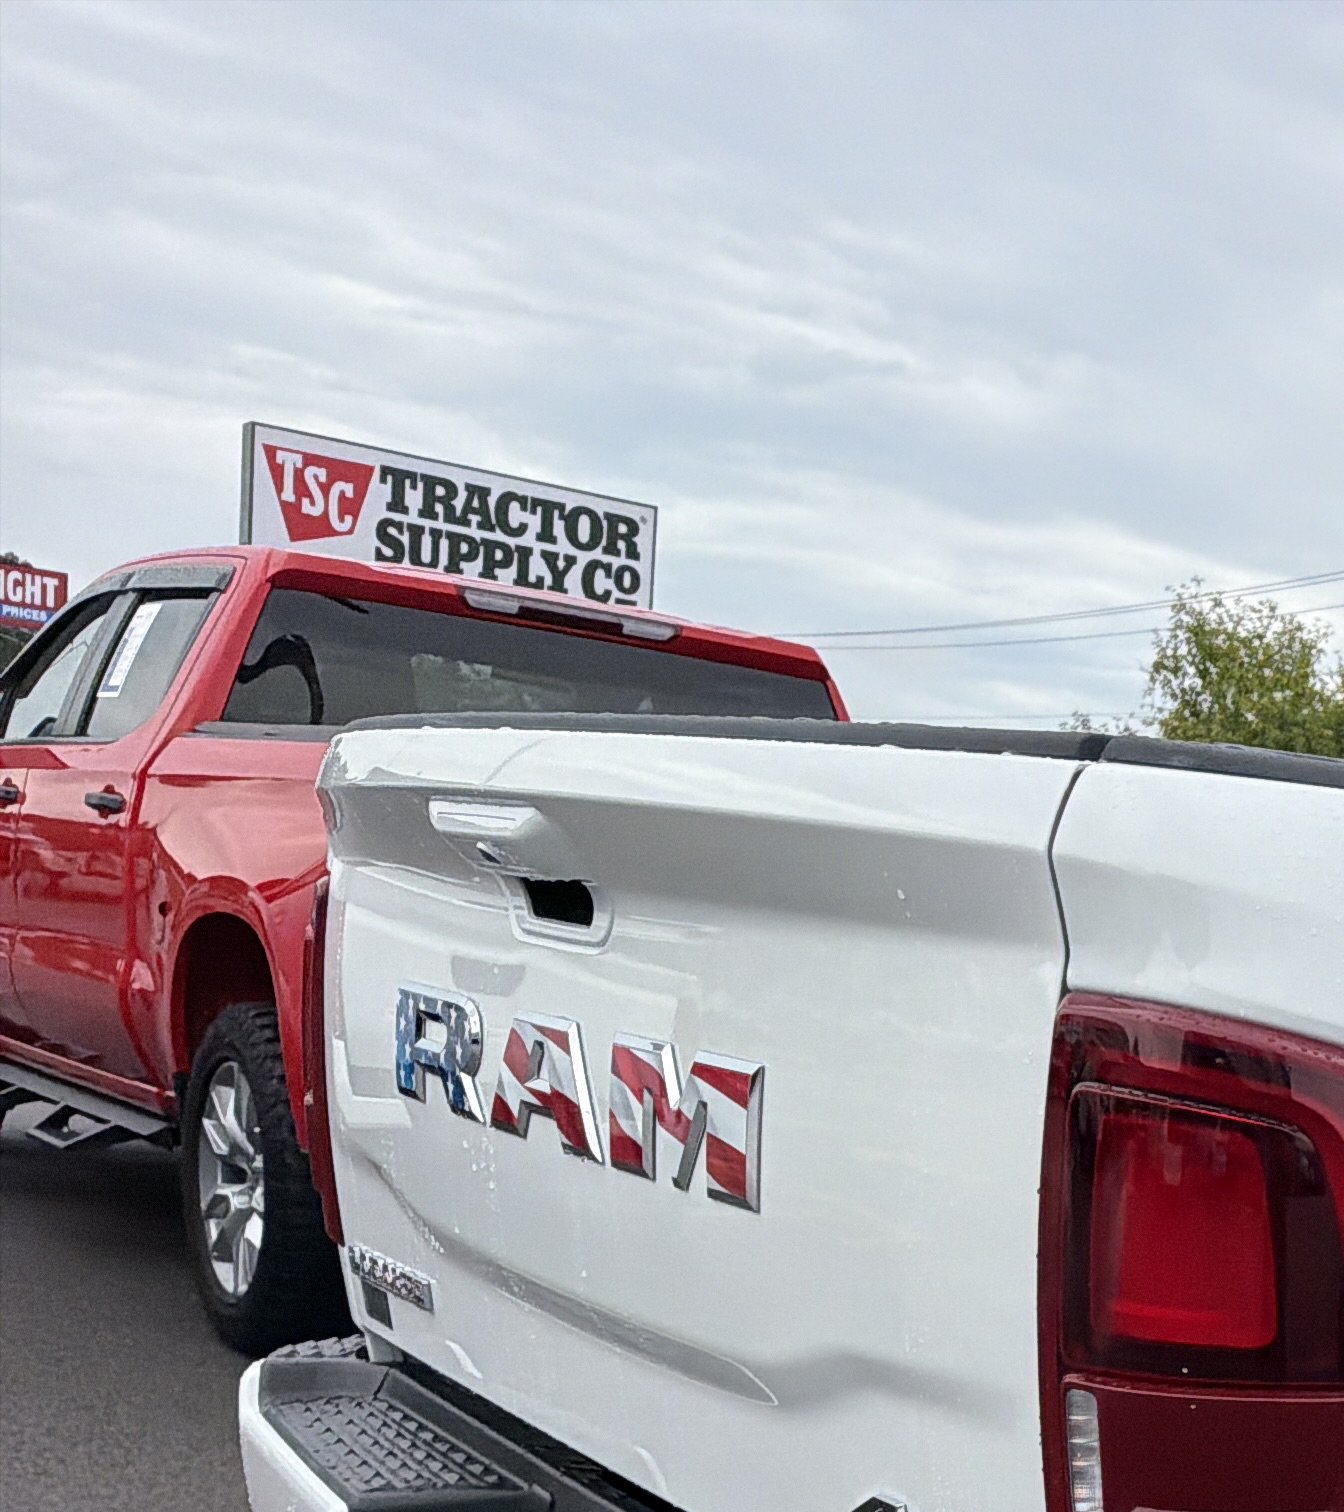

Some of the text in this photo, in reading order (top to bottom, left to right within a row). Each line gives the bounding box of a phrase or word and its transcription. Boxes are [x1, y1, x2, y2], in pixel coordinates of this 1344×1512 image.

[276, 450, 354, 533] TSC
[379, 464, 642, 562] TRACTOR
[374, 517, 578, 594] SUPPLY
[395, 982, 766, 1215] RAM
